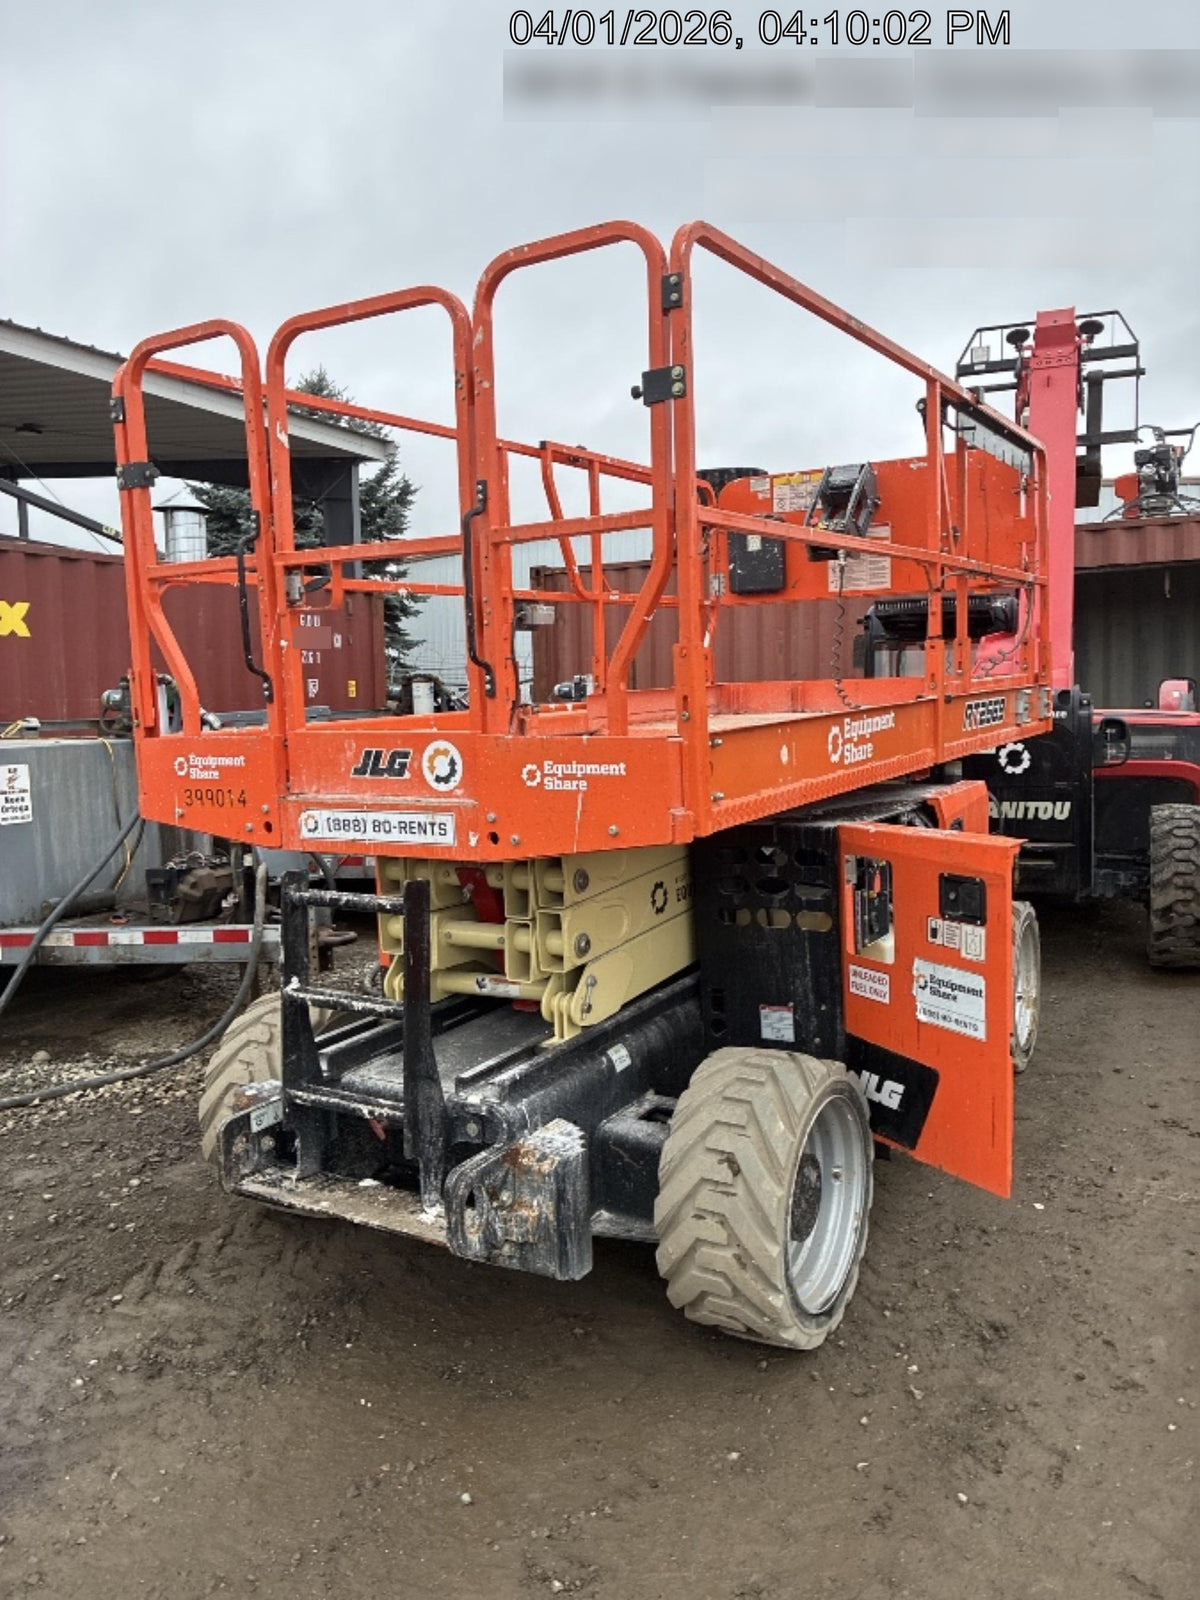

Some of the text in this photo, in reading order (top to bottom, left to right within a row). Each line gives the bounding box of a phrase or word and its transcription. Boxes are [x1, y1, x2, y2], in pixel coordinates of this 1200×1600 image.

[844, 709, 895, 742] Equipment
[189, 754, 245, 769] Equipment
[844, 742, 873, 765] Share
[351, 749, 411, 779] JLG
[543, 760, 626, 777] Equipment
[189, 767, 220, 780] Share
[543, 776, 588, 791] Share
[184, 788, 246, 808] 399014
[989, 801, 1072, 820] ANITOU
[326, 817, 368, 835] (888)
[929, 973, 983, 998] Equipment
[929, 986, 958, 1002] Share
